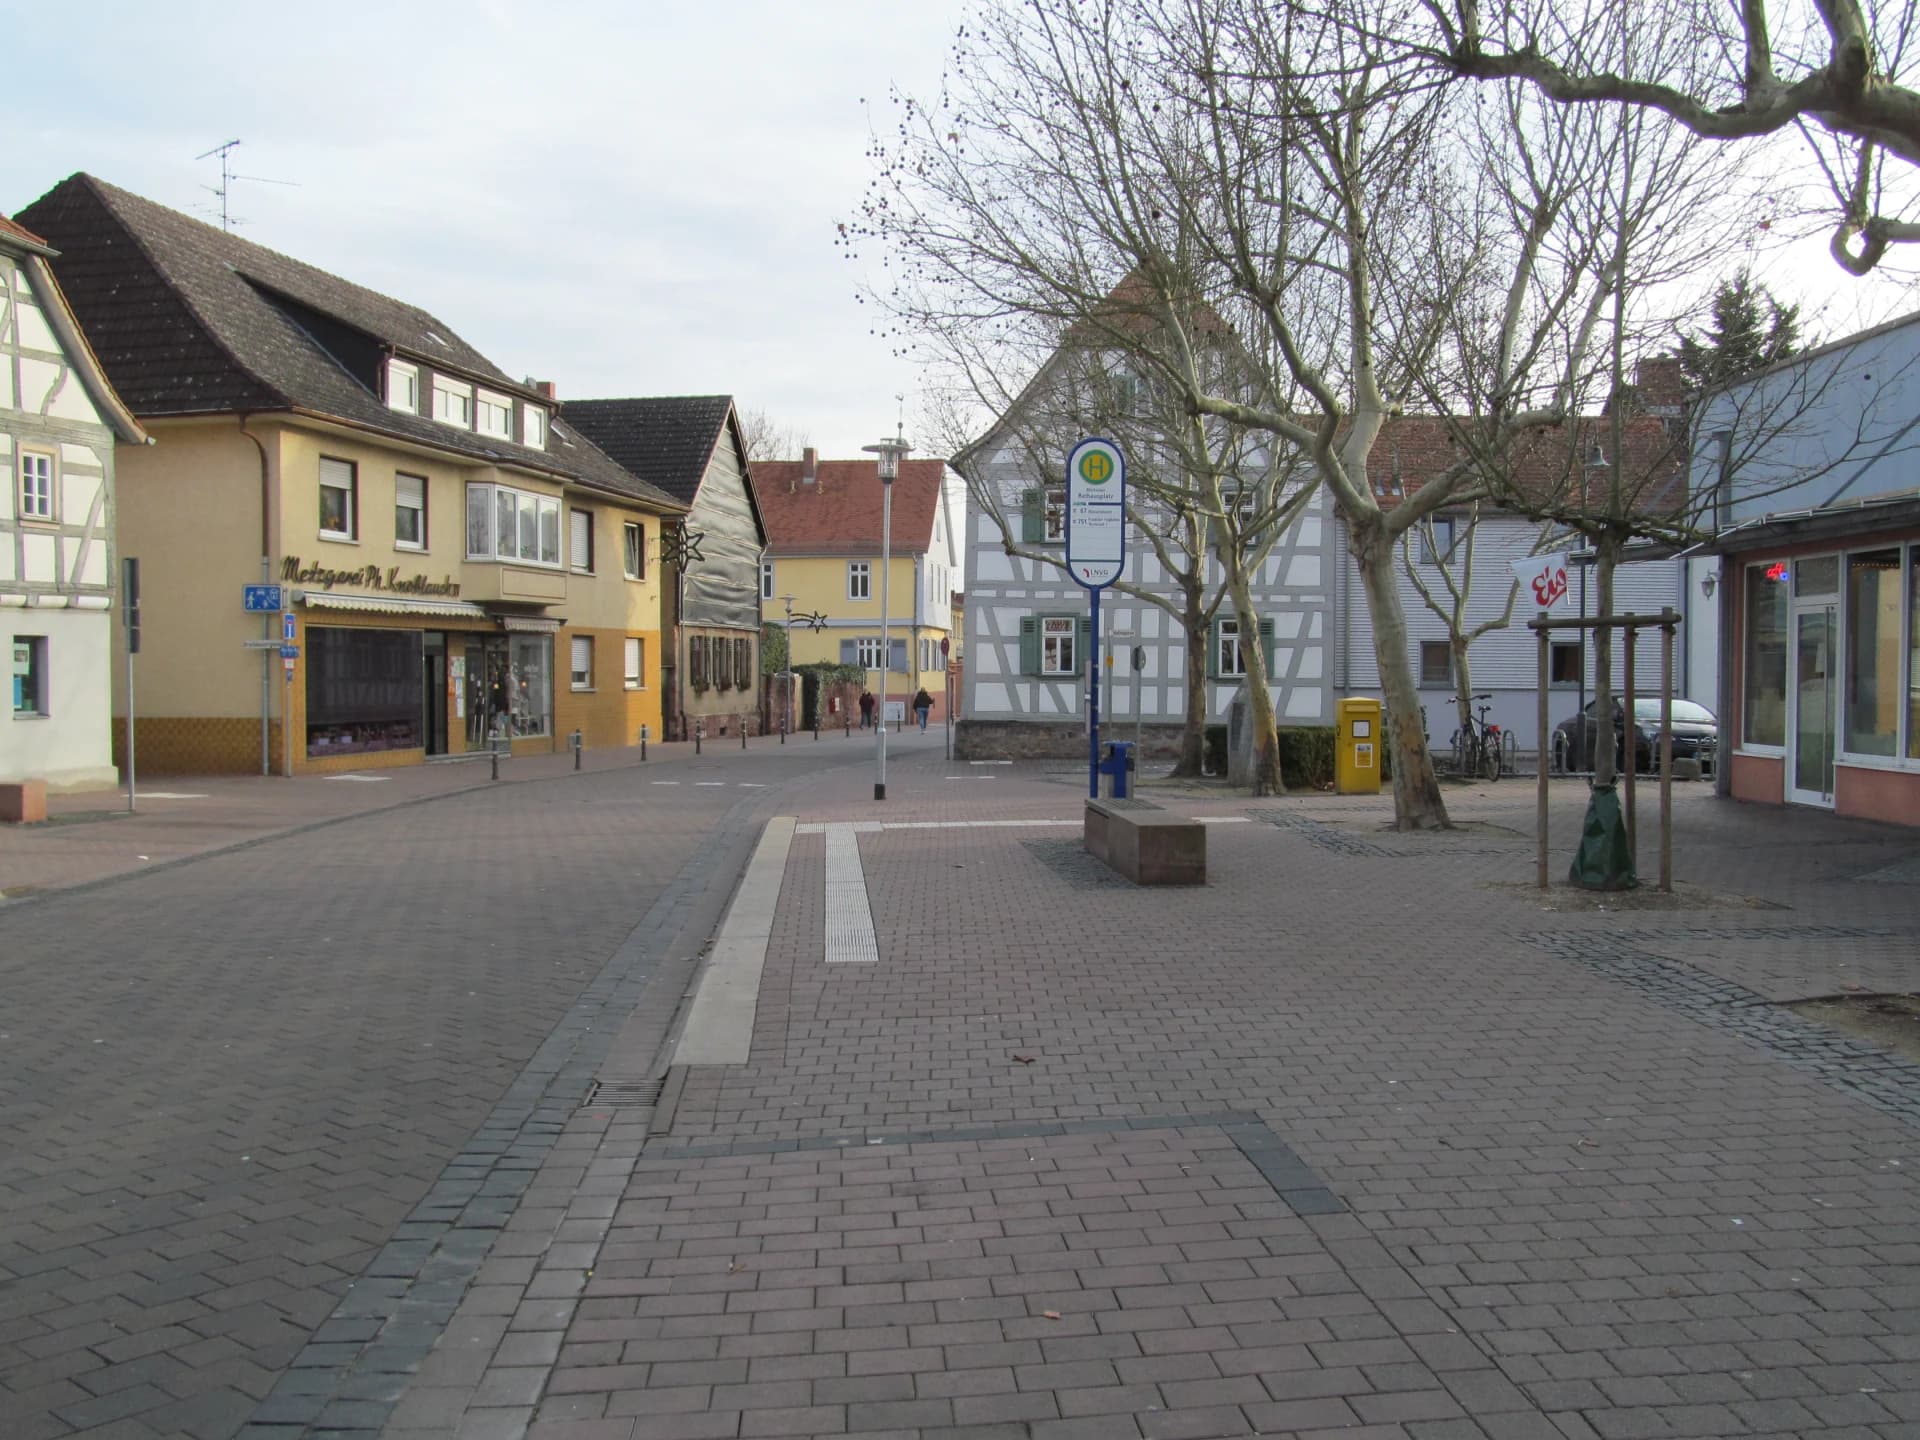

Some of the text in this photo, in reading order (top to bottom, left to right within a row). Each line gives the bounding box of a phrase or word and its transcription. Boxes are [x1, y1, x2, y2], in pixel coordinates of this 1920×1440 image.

[1089, 456, 1104, 478] H
[280, 555, 364, 590] Metzgerei
[386, 566, 453, 598] Knoblauch
[1532, 565, 1568, 608] Eis
